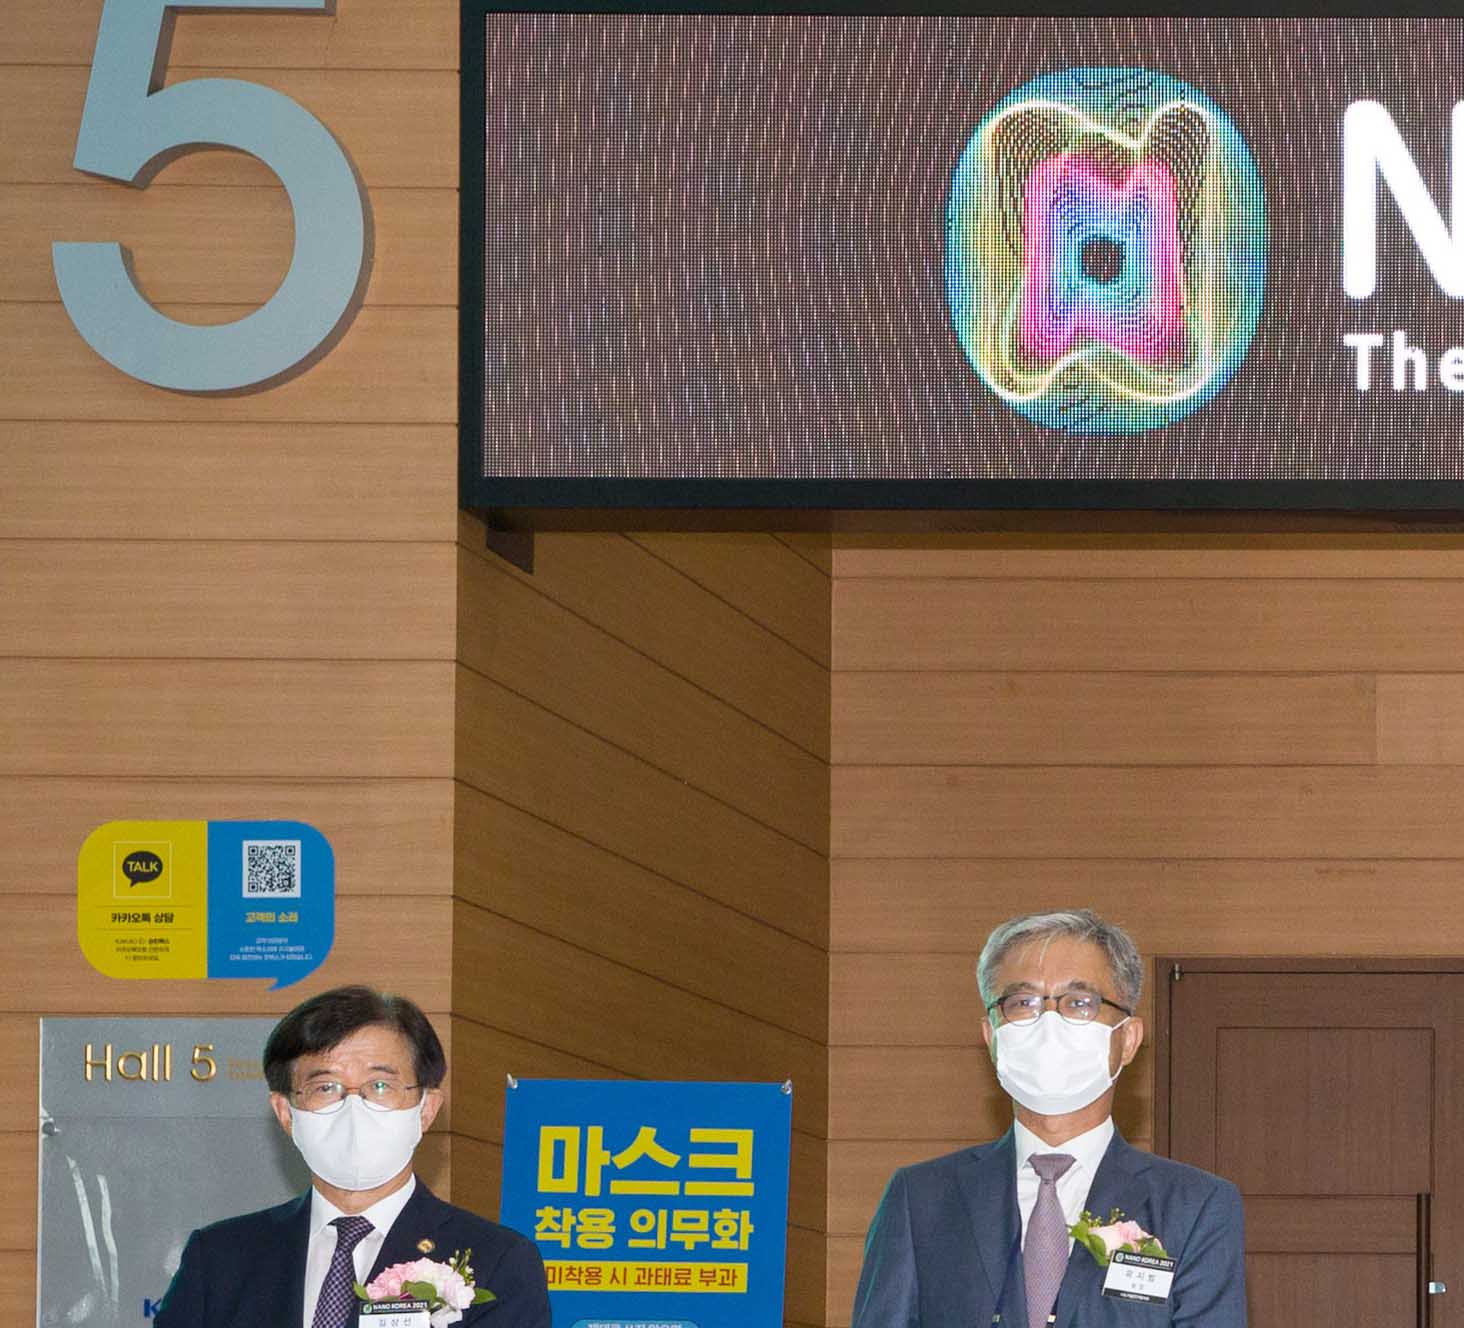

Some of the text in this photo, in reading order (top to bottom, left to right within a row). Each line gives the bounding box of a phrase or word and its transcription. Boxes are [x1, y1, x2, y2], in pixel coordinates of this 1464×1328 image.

[52, 0, 365, 392] 5
[126, 860, 159, 873] TALK
[84, 1043, 173, 1082] Hall
[190, 1043, 217, 1082] 5
[537, 1126, 755, 1197] 마스크
[534, 1206, 754, 1251] 착용 의무화
[547, 1266, 738, 1288] 미착용 시 과태료 부과
